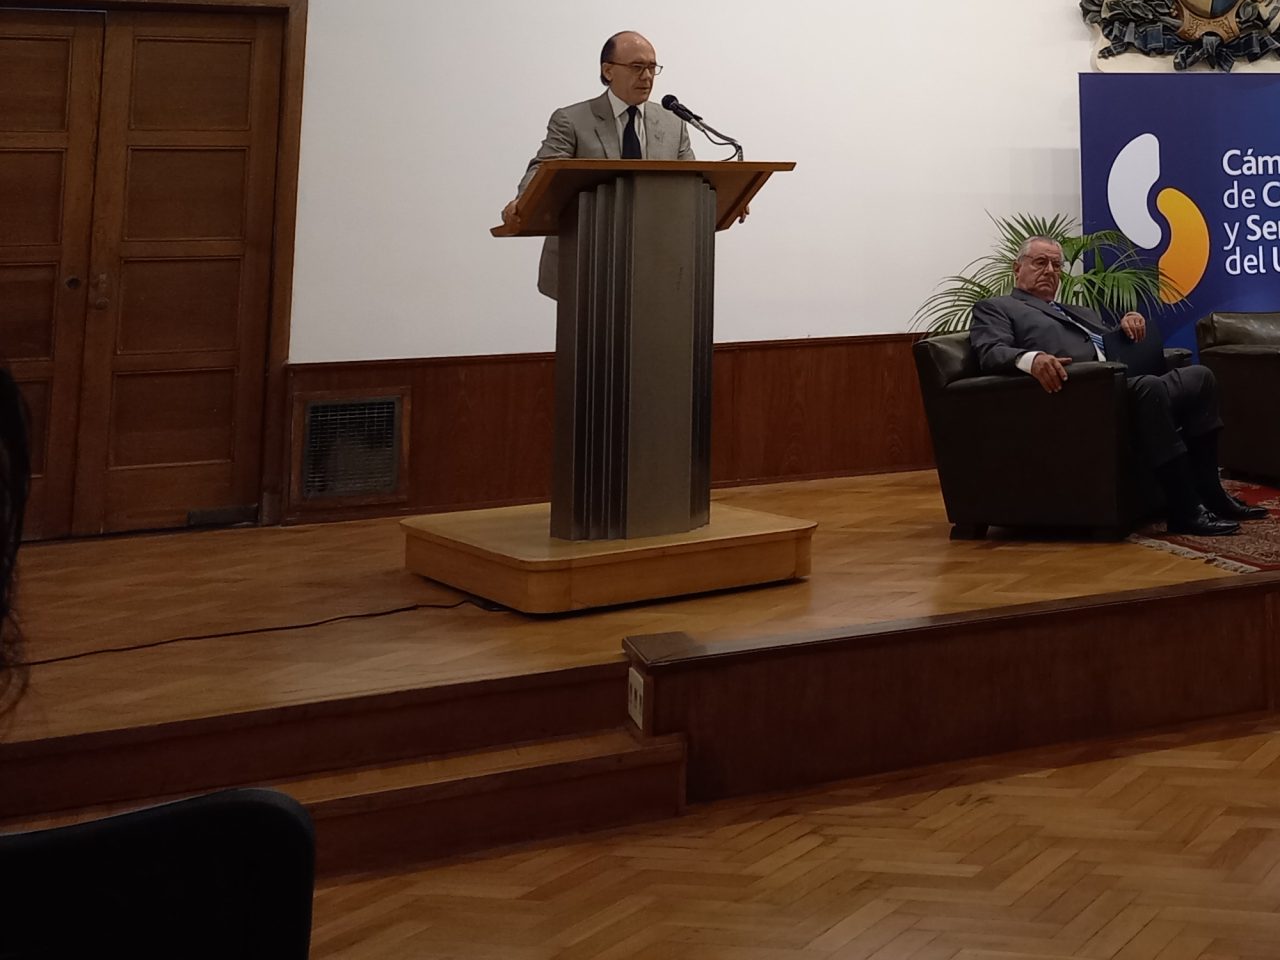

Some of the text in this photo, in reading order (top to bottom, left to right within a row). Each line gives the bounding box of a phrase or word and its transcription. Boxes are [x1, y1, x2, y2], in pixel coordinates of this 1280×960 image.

[1223, 181, 1256, 209] de
[1223, 220, 1240, 250] y
[1225, 246, 1266, 275] del
